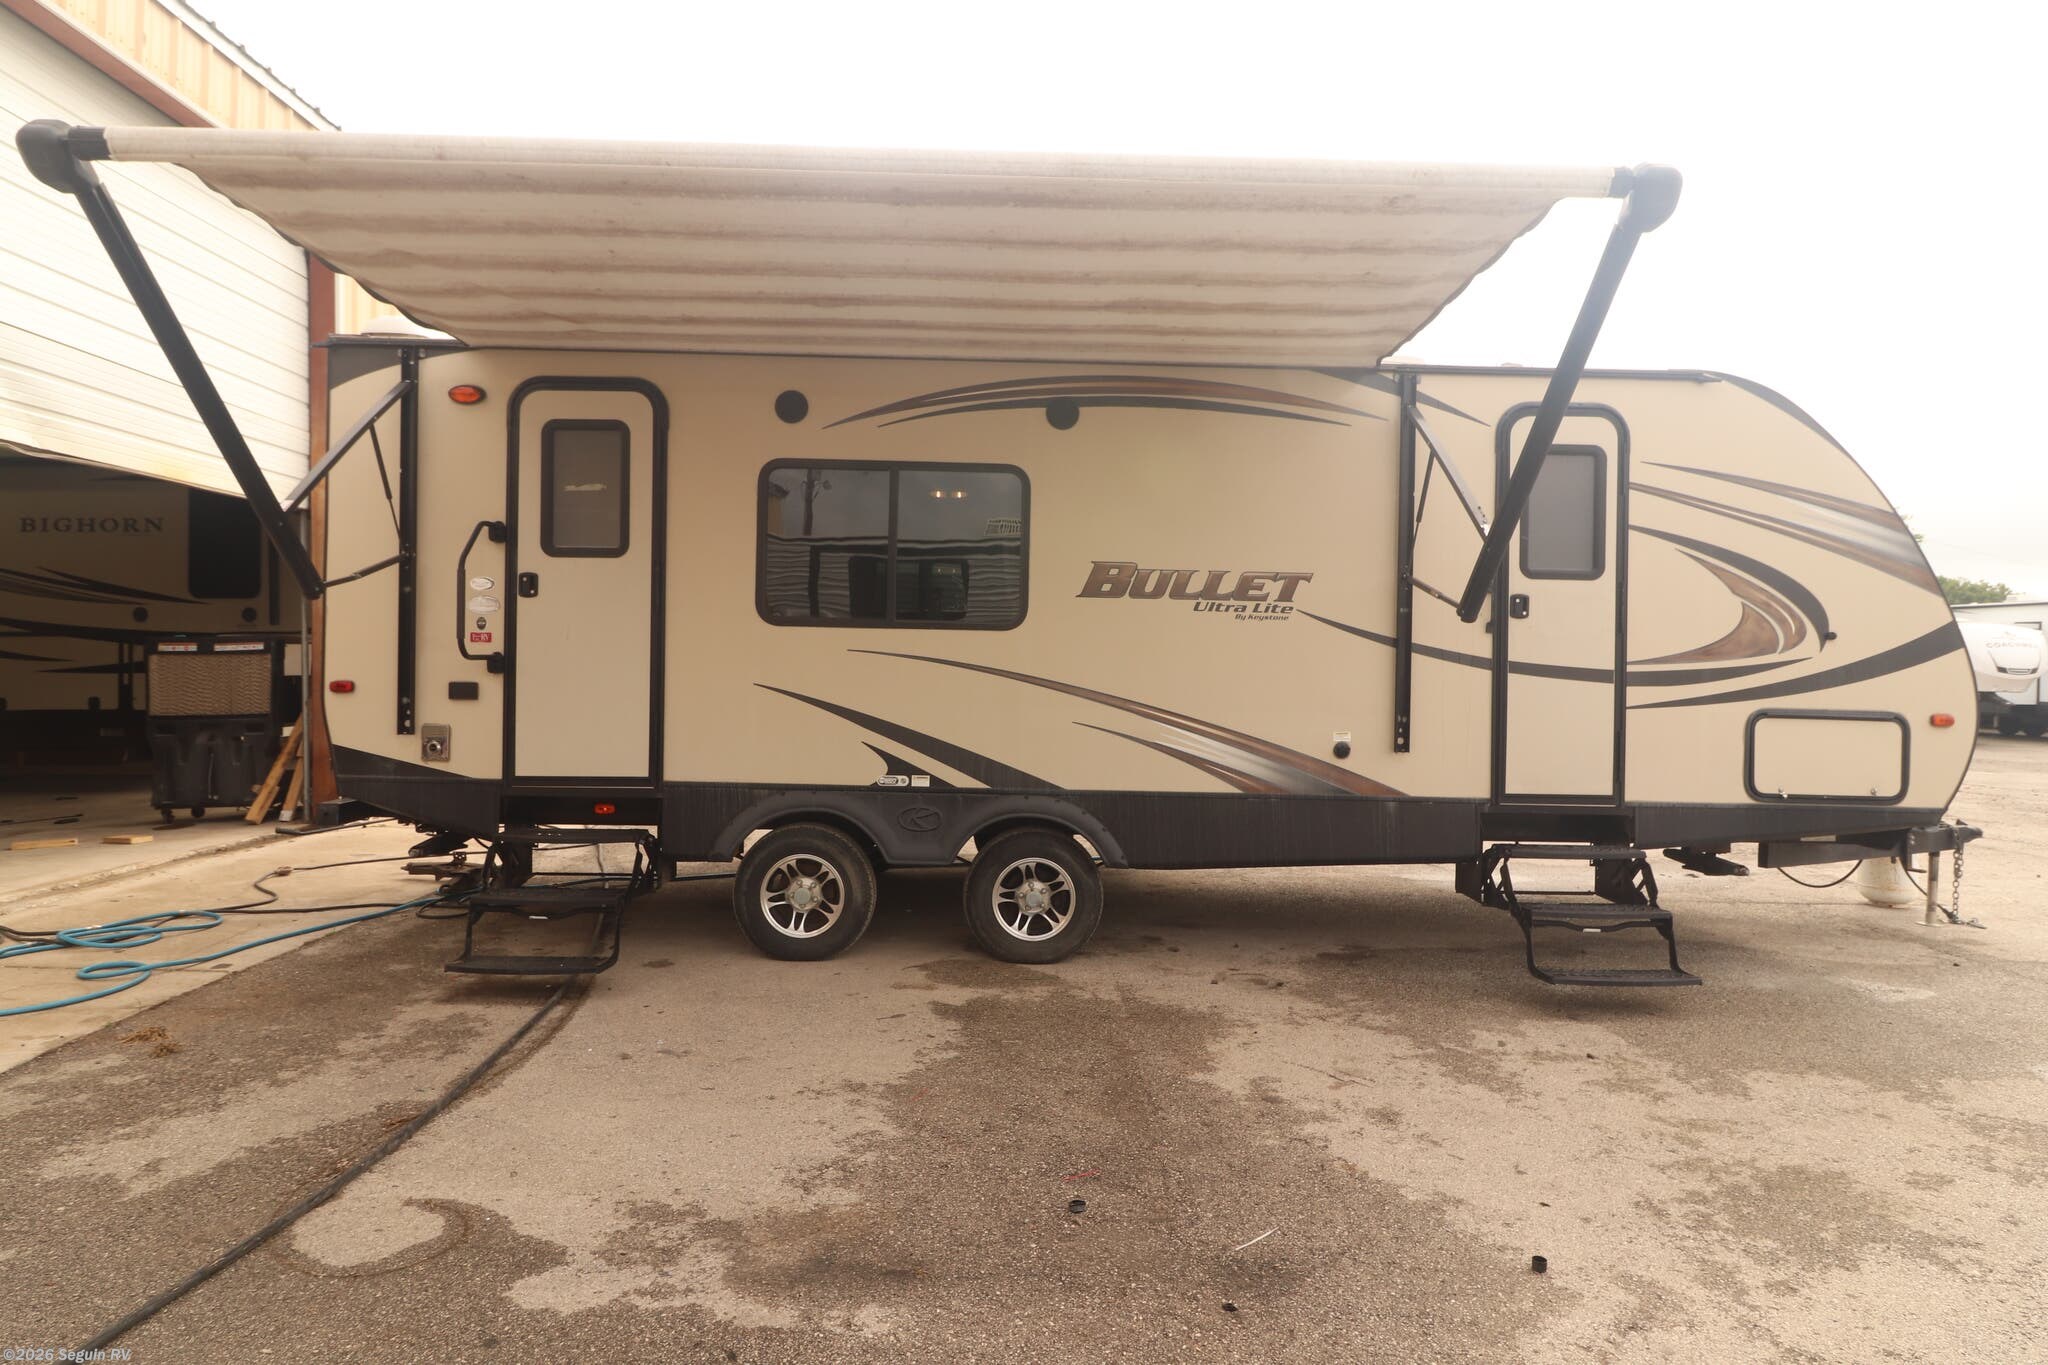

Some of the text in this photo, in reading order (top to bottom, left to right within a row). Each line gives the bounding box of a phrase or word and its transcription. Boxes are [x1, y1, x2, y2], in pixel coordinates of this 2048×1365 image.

[19, 516, 164, 533] BIGHORN
[1076, 561, 1313, 602] BULLET
[1193, 601, 1293, 614] Ultra Lite
[1235, 613, 1289, 621] By Keystone
